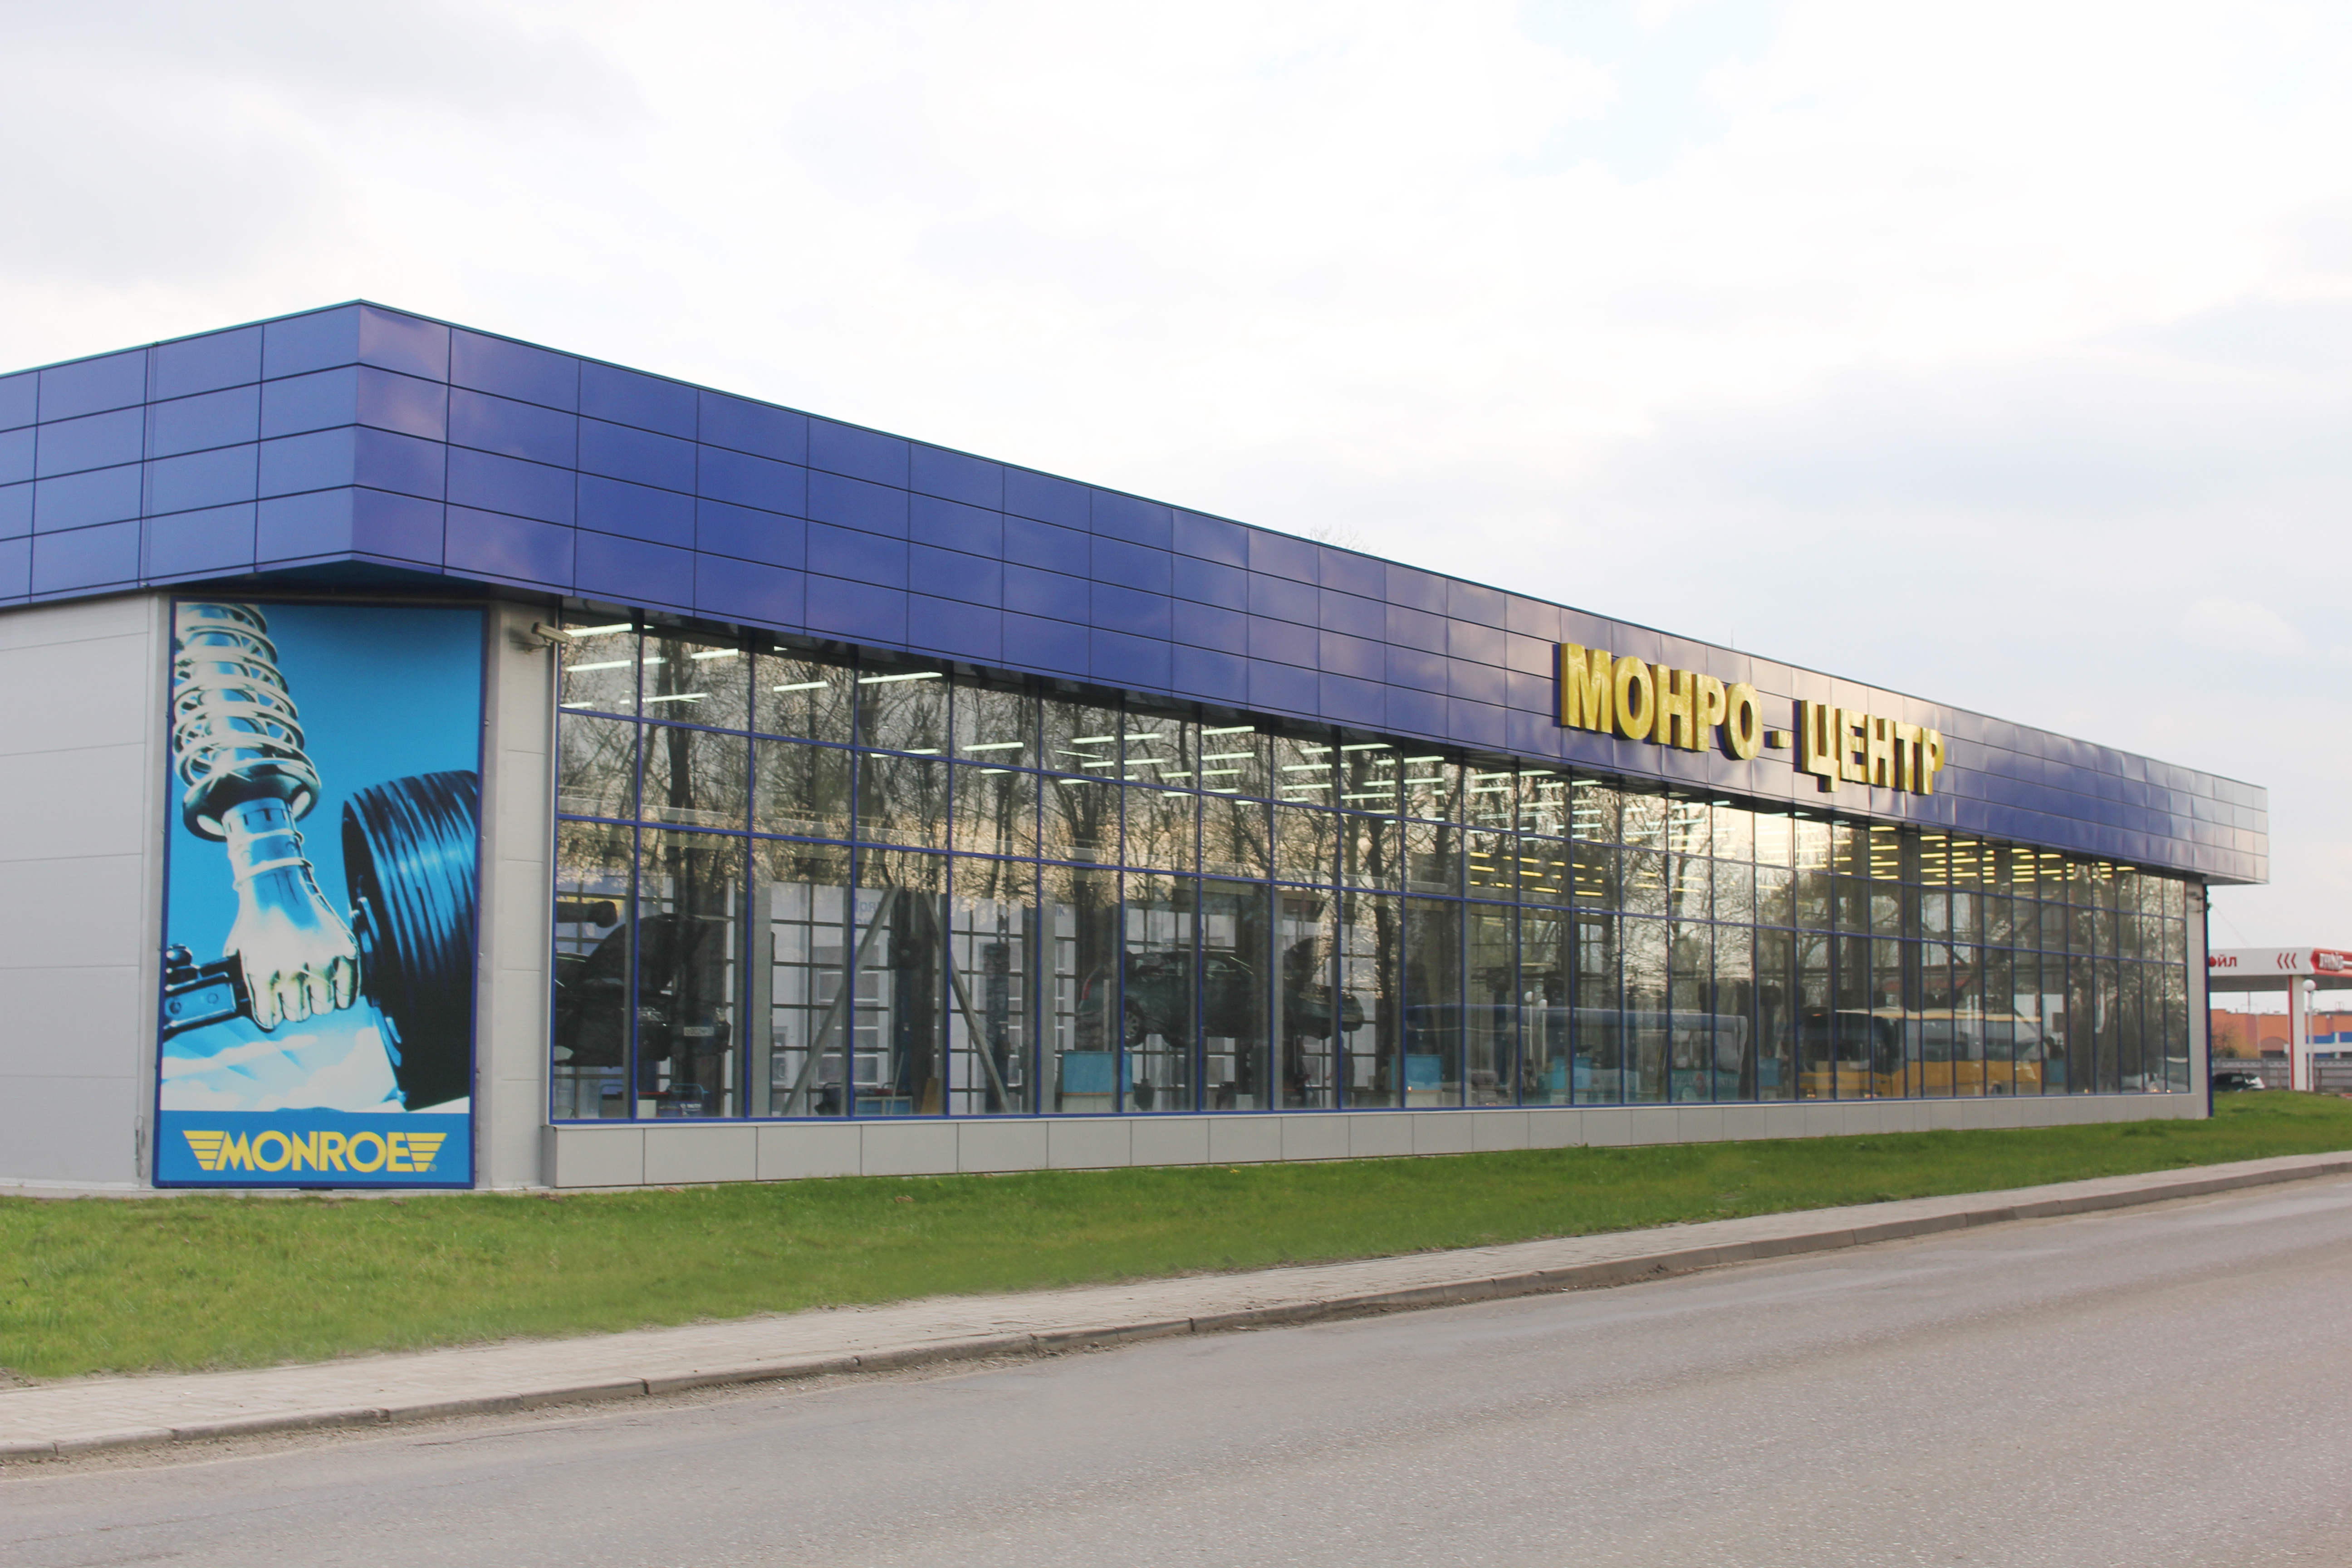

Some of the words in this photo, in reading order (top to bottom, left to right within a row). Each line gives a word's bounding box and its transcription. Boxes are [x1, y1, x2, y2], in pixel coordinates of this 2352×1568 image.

[1561, 642, 1762, 760] МОНРО
[1801, 700, 1944, 795] ЦЕНТР
[215, 1130, 414, 1172] MONROE
